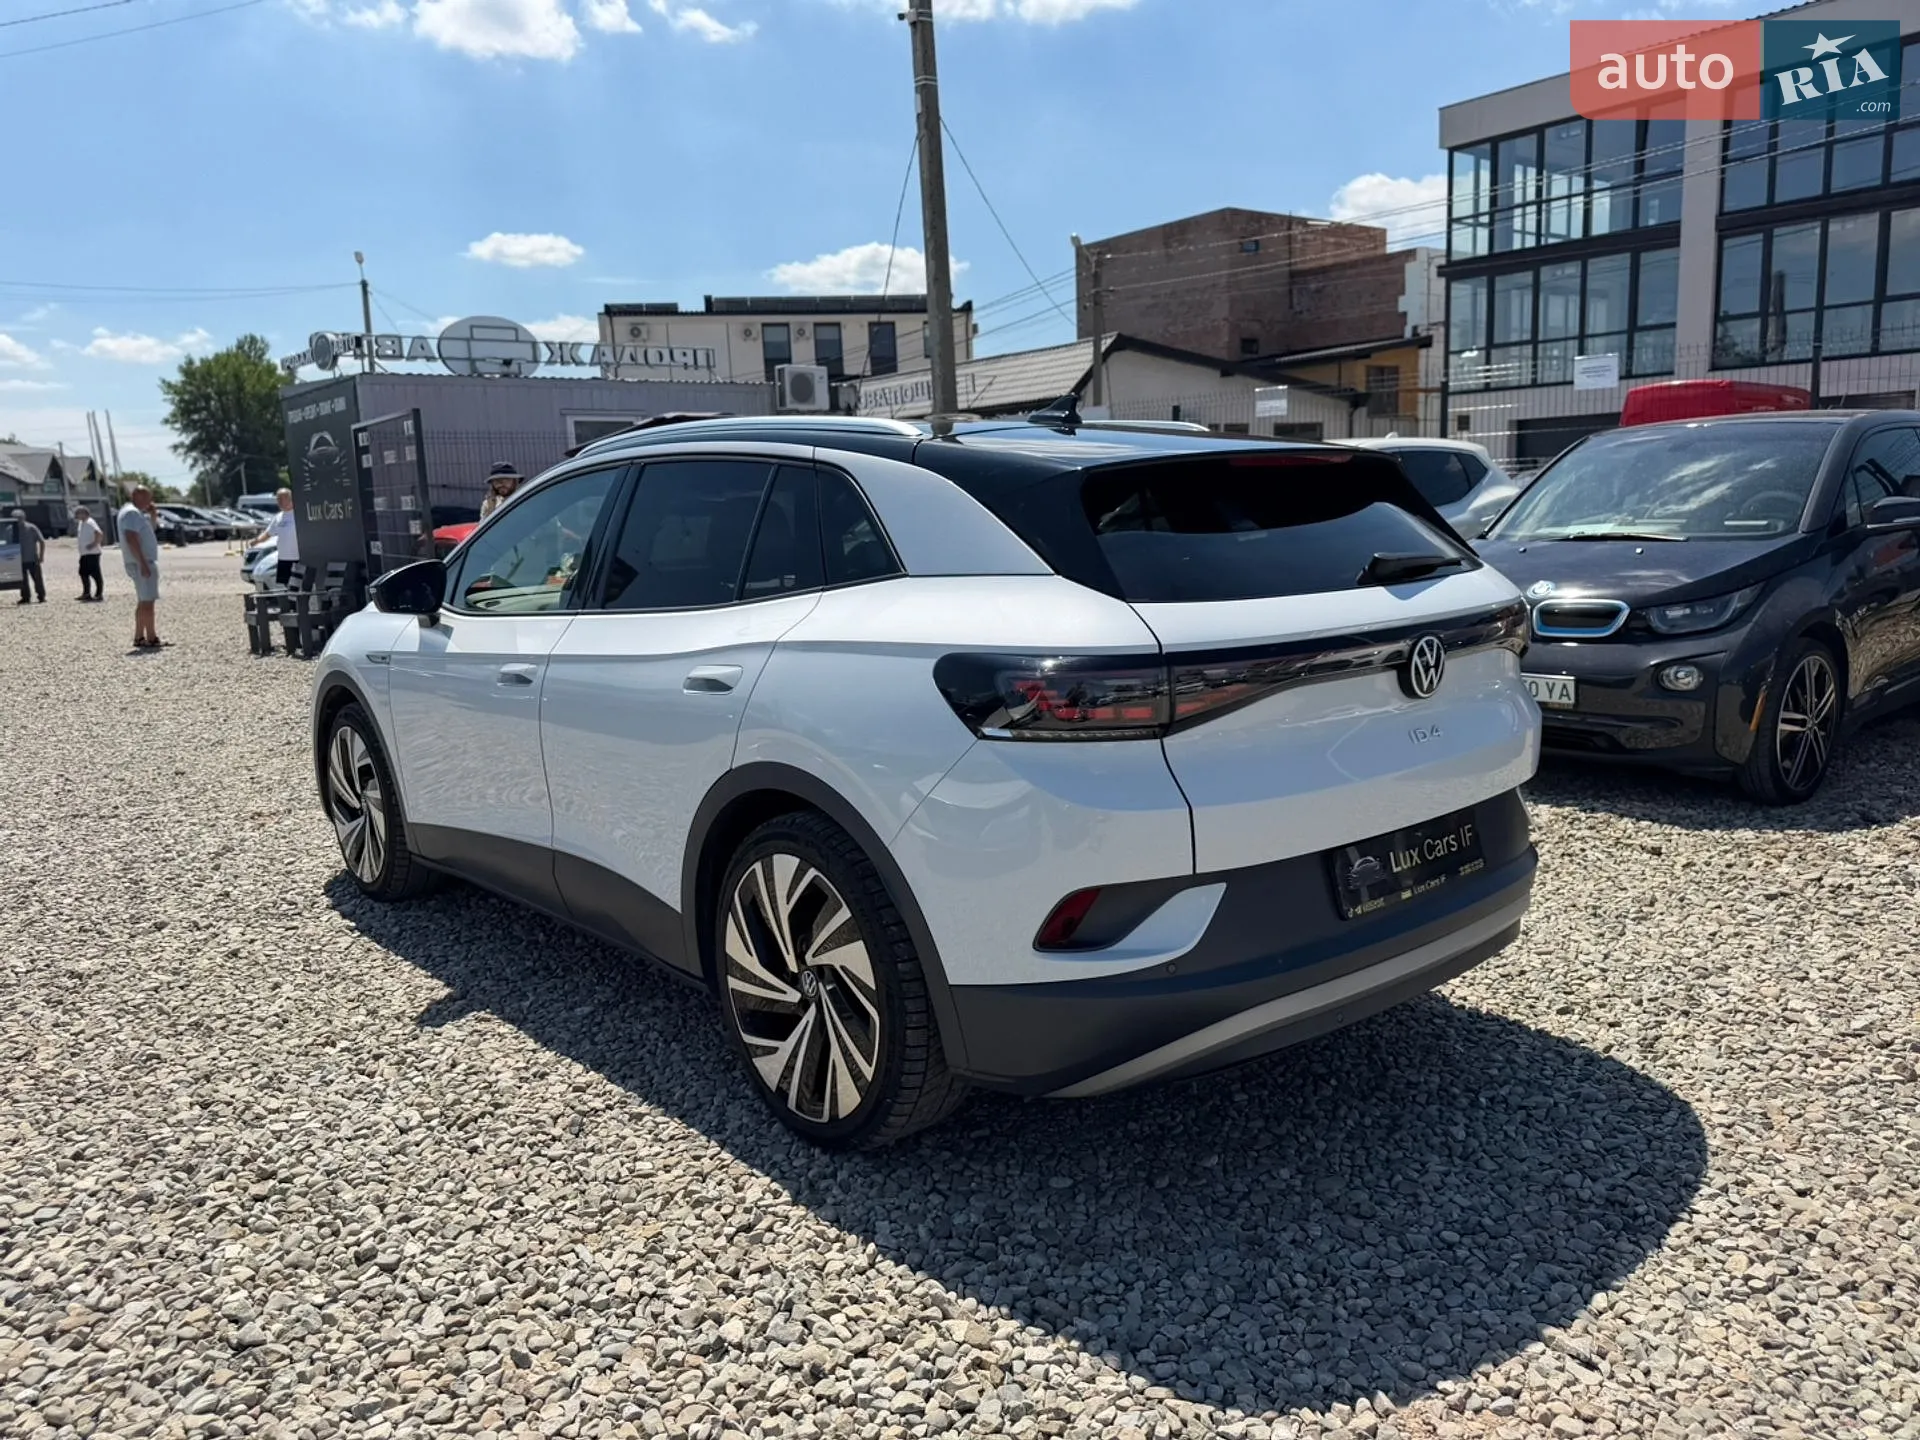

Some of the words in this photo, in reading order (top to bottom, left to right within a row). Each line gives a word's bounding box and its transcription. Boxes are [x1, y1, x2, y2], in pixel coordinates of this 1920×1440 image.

[306, 502, 323, 521] Lux
[323, 500, 344, 520] Cars
[1545, 681, 1572, 701] YA
[1389, 847, 1422, 873] Lux
[1424, 833, 1458, 860] Cars
[1459, 824, 1473, 847] IF
